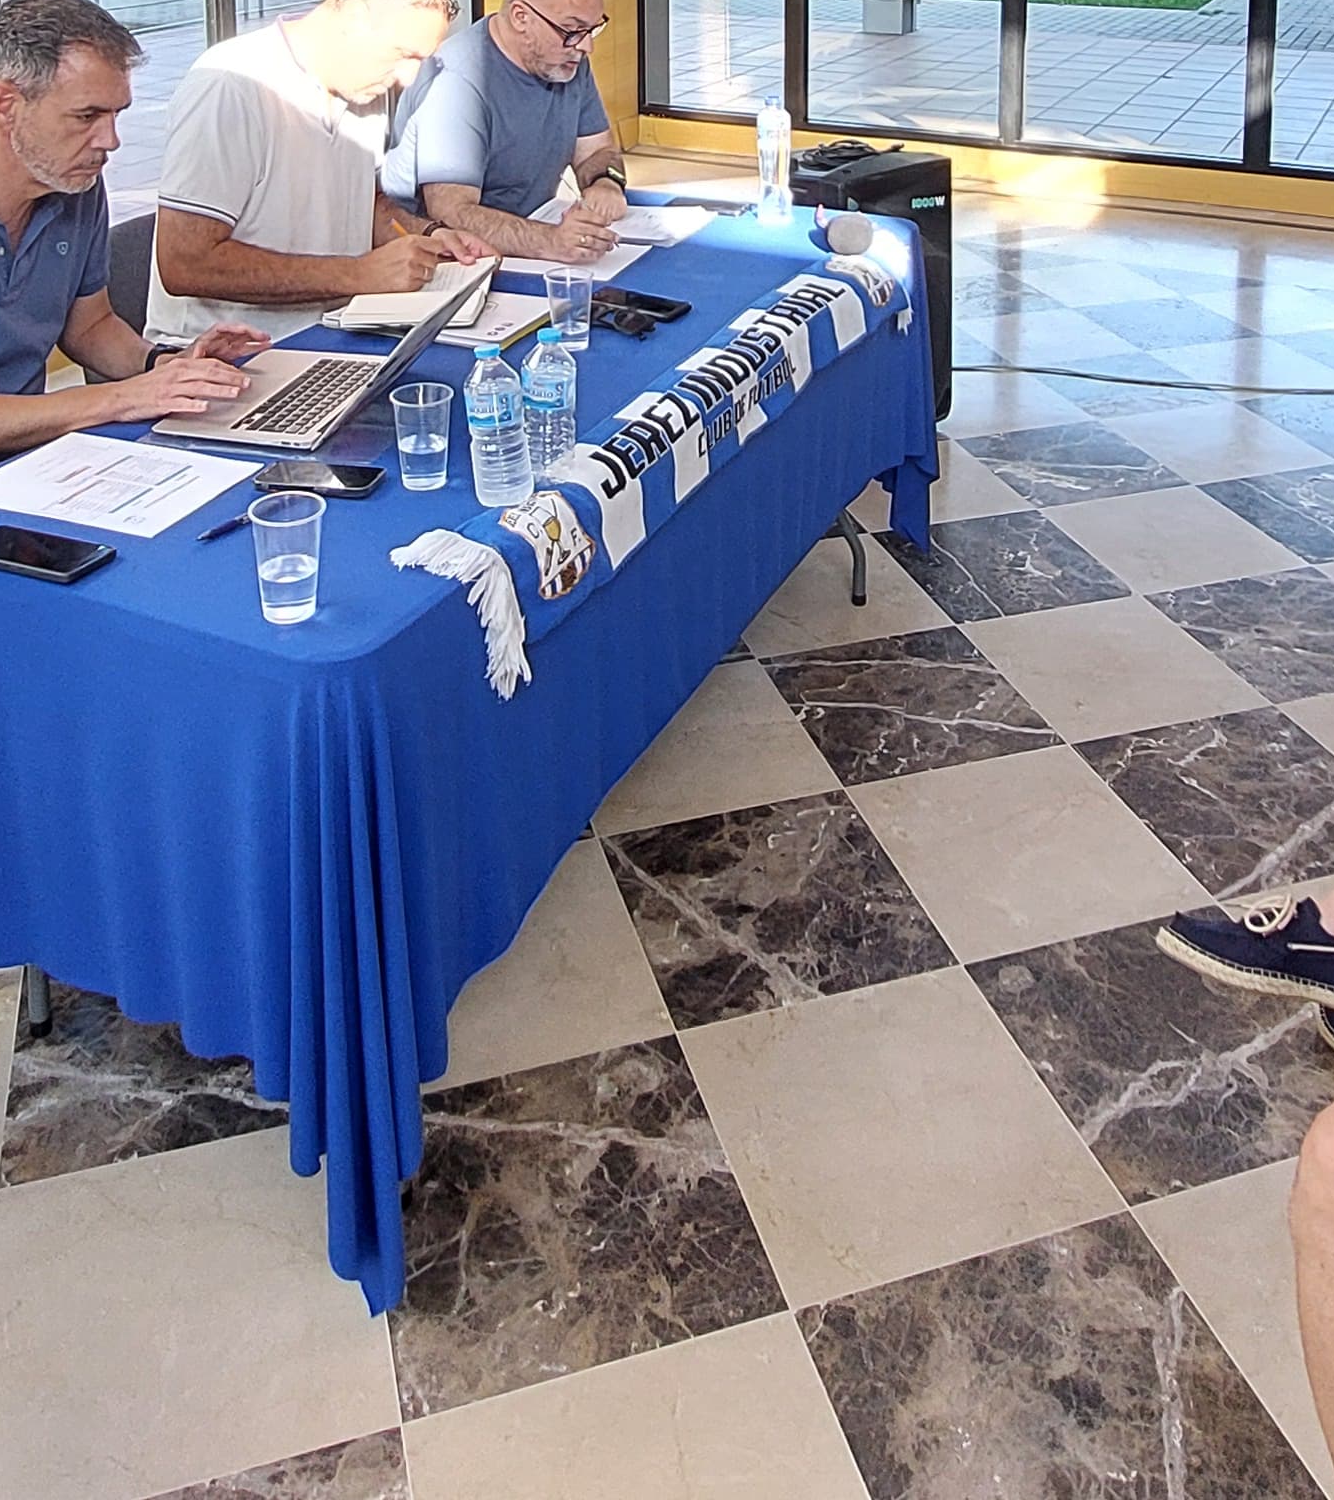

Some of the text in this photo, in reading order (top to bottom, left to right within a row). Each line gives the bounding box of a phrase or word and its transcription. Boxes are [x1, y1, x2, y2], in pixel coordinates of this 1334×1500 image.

[590, 283, 847, 499] JEREZ INDUSTRIAL
[698, 408, 732, 457] CLUB
[734, 393, 747, 424] DE
